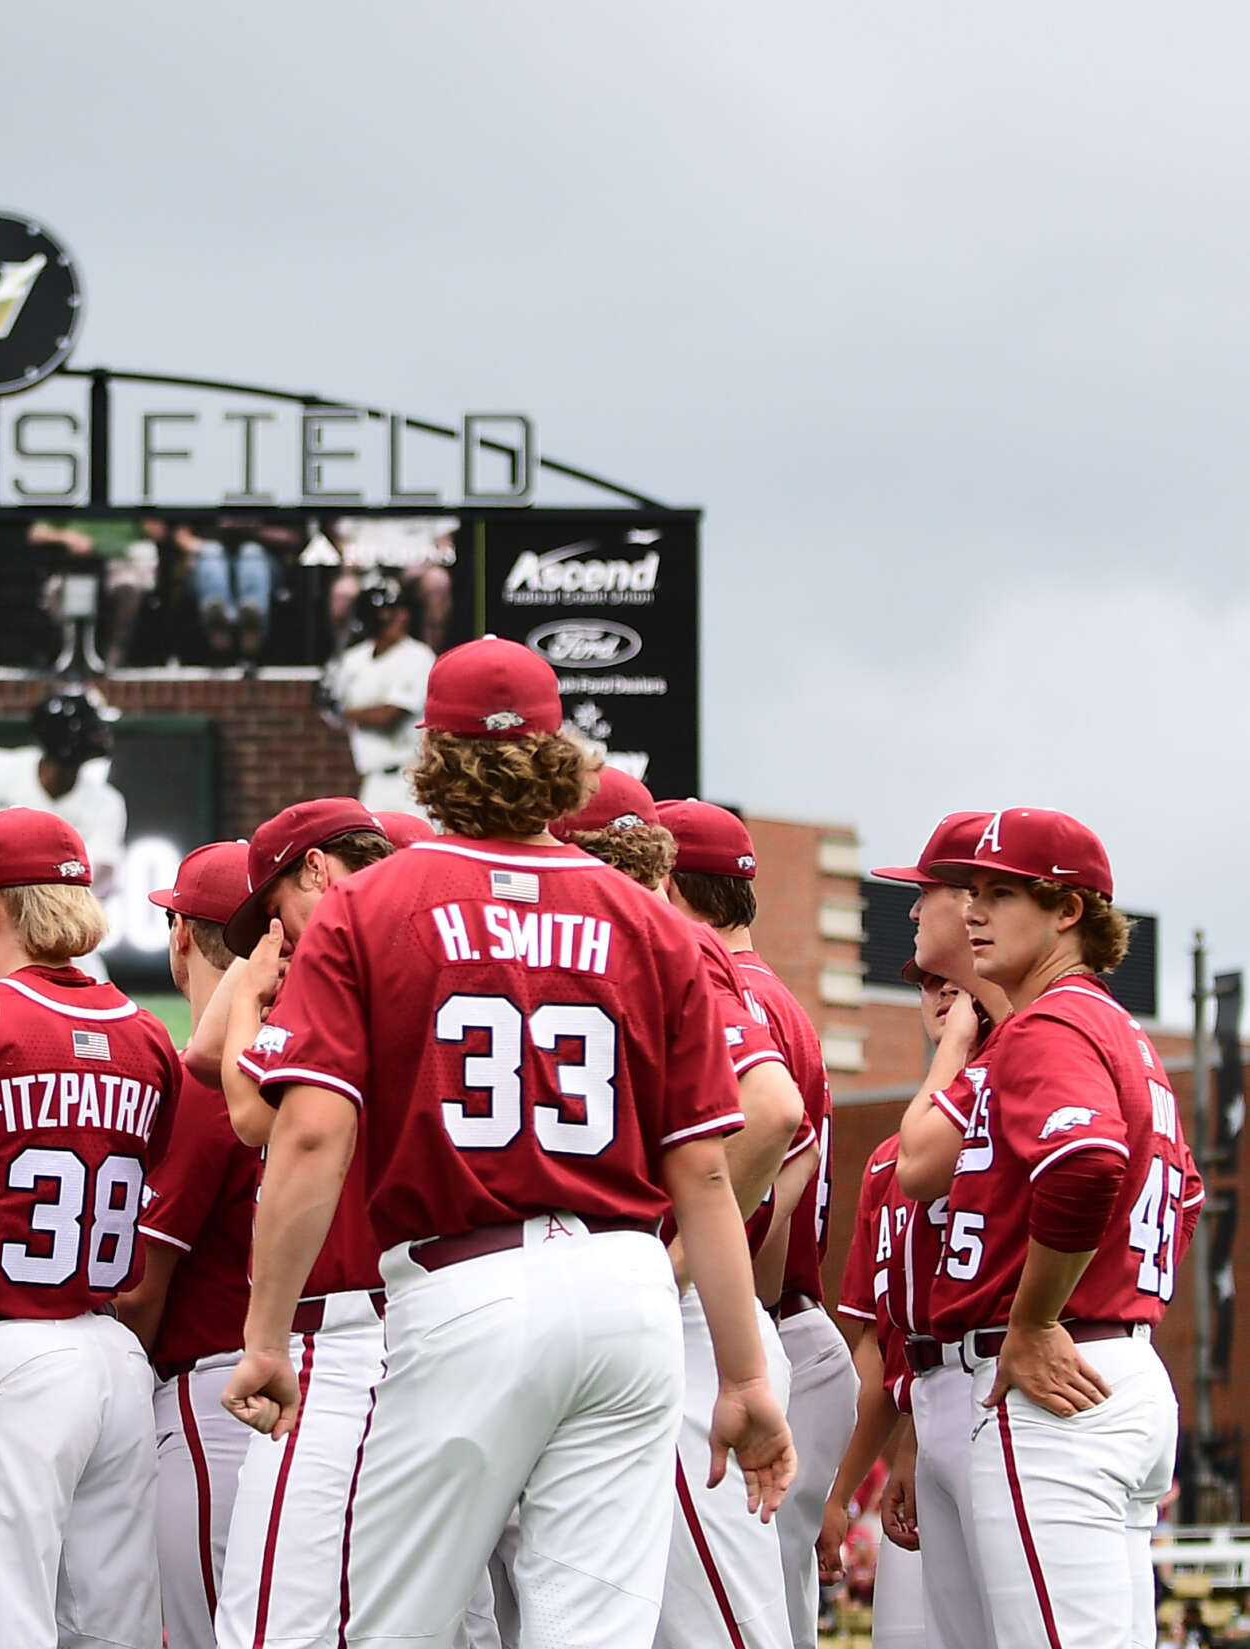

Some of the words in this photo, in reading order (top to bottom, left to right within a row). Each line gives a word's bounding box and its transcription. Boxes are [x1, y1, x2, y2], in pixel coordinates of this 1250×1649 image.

[140, 410, 538, 506] FIELD
[502, 549, 660, 592] Ascend
[548, 632, 621, 660] Ford
[974, 810, 1002, 857] A
[432, 904, 481, 961] H.
[483, 905, 612, 975] SMITH
[435, 992, 618, 1157] 33
[0, 1147, 145, 1290] 38
[1128, 1154, 1184, 1304] 45
